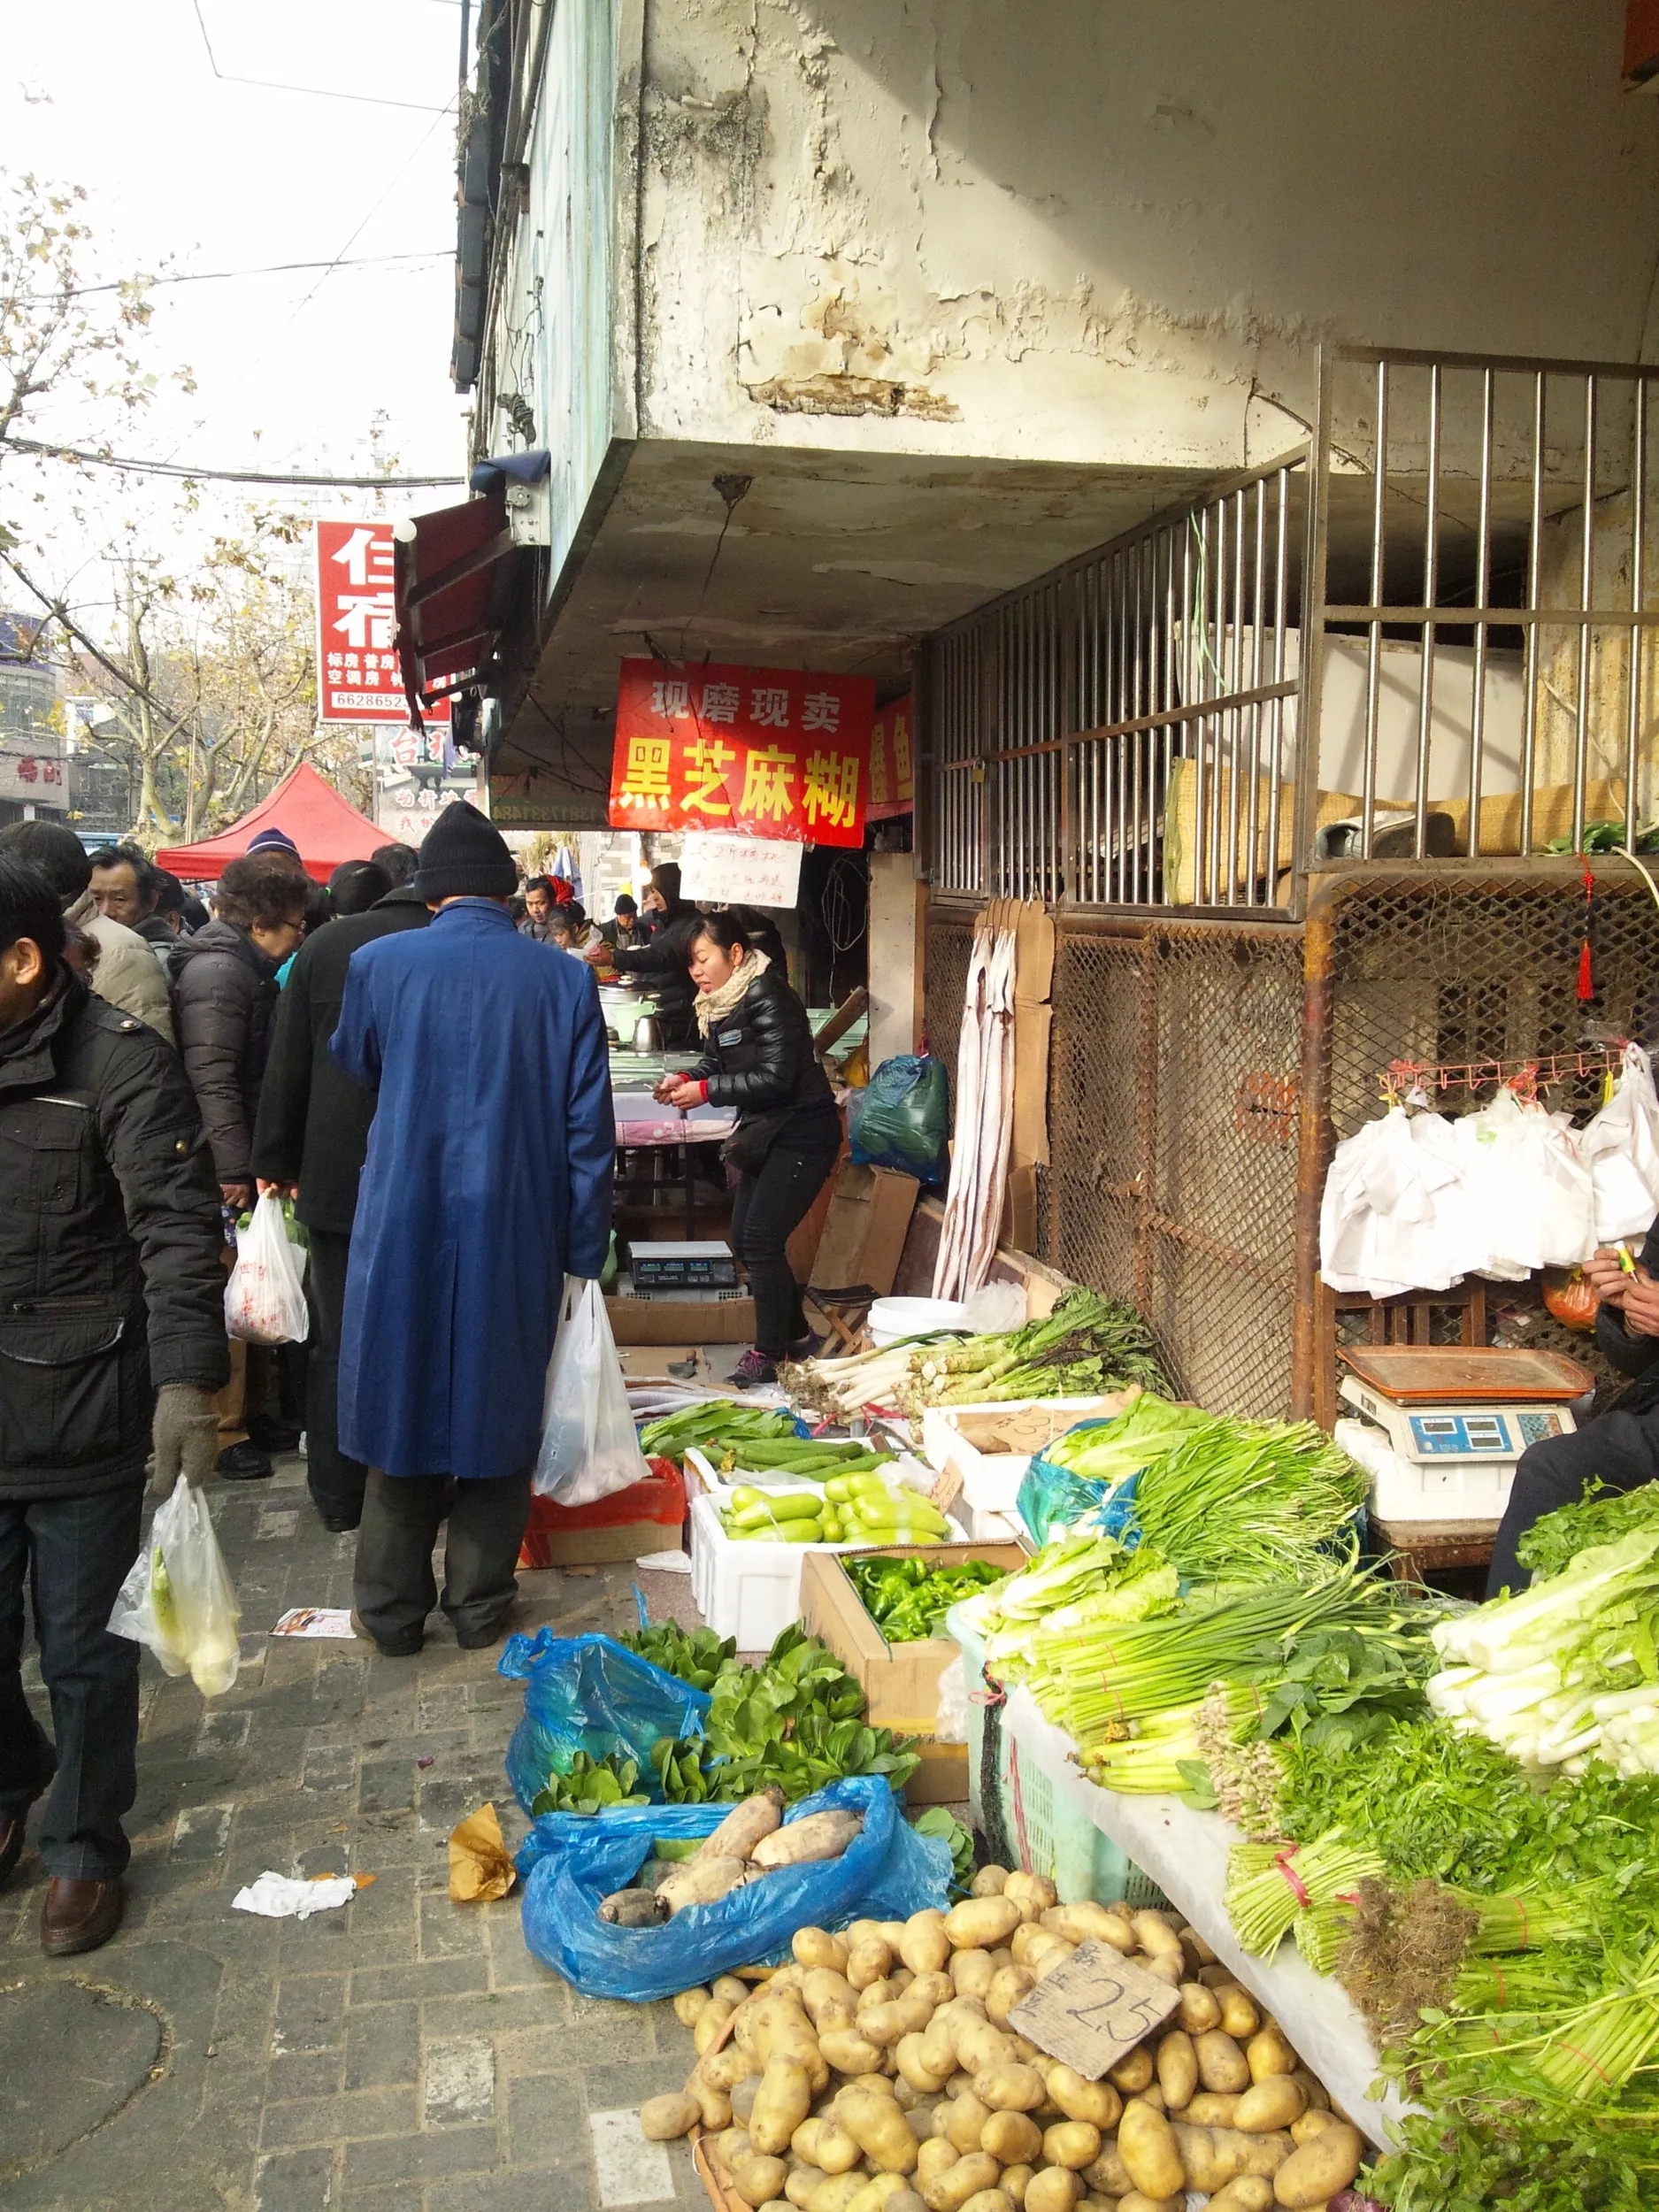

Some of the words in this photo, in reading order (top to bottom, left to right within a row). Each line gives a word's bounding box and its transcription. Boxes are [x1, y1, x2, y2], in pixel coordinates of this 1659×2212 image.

[327, 651, 359, 669] 标房
[327, 669, 380, 686] 空调房
[650, 680, 841, 733] 现磨现卖
[620, 737, 860, 828] 黑芝麻糊
[1066, 1978, 1162, 2042] 2.5
